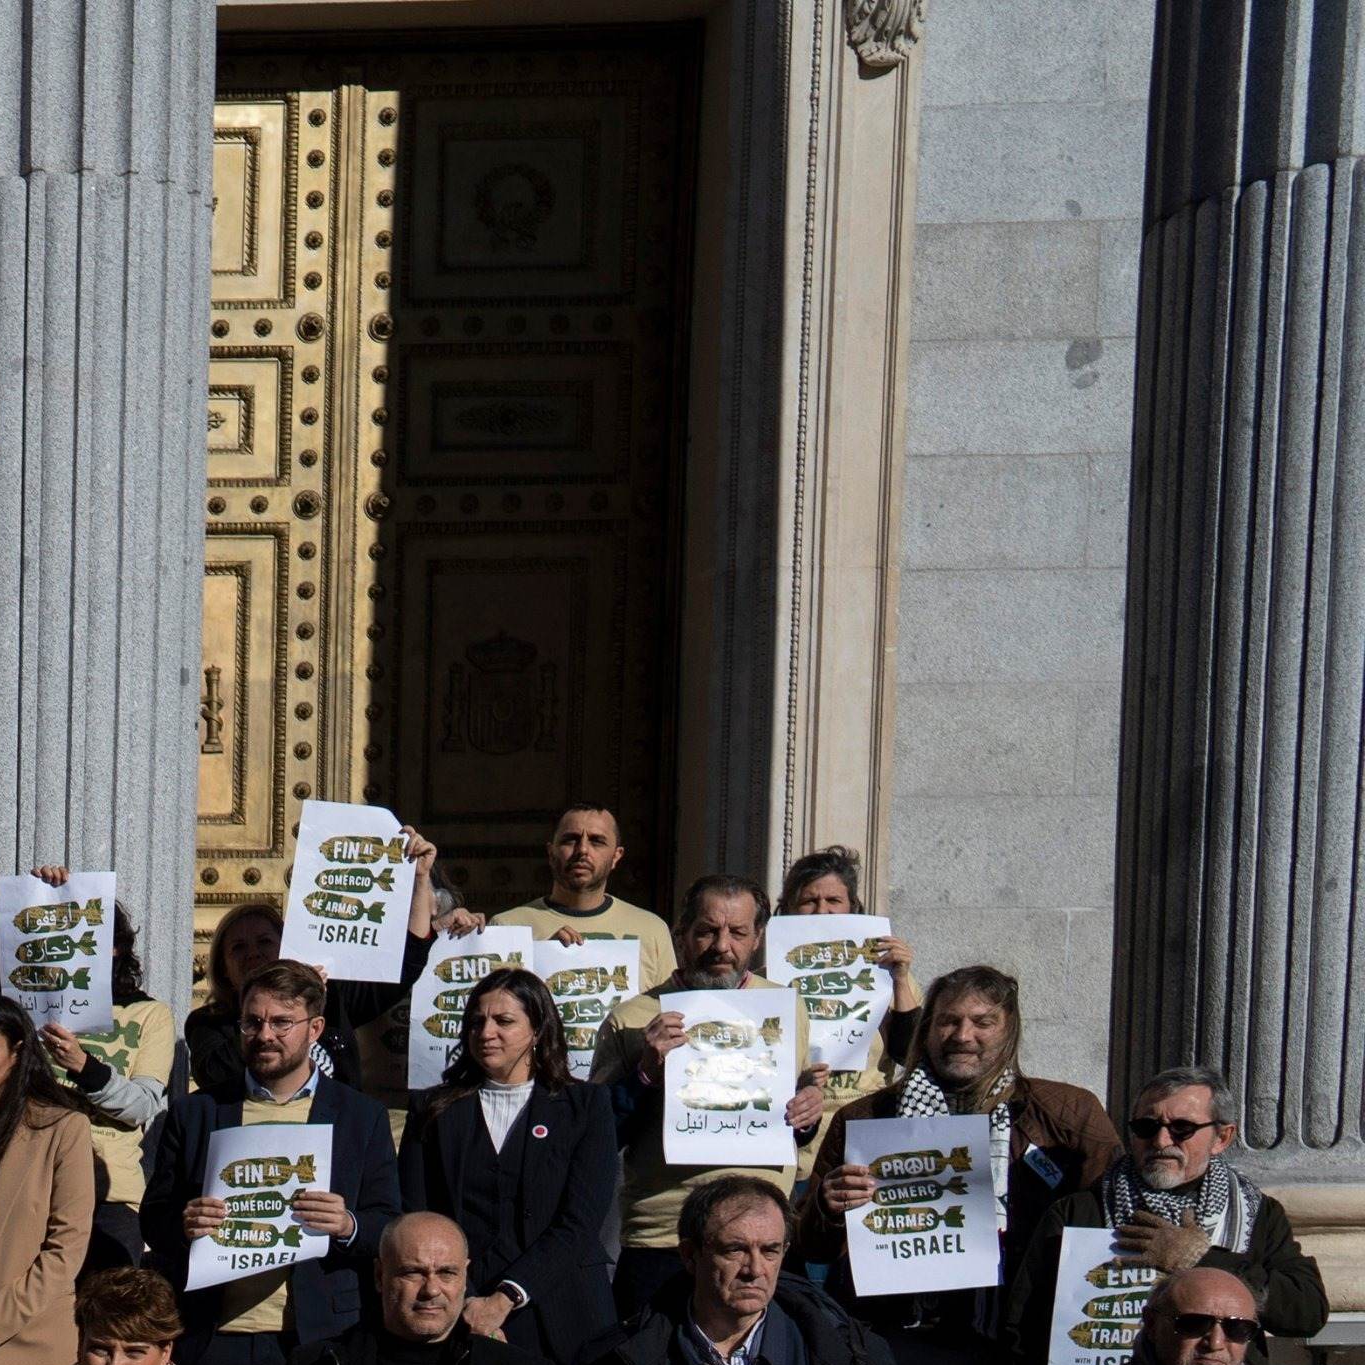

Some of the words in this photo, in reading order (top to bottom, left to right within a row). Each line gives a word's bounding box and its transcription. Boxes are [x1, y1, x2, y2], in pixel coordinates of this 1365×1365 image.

[334, 841, 359, 859] FIN
[321, 875, 371, 888] COMERCIO
[325, 902, 359, 915] ARMAS
[319, 924, 378, 947] ISRAEL
[234, 1165, 263, 1184] FIN
[878, 1184, 937, 1202] COMERÇ
[224, 1200, 282, 1213] COMERCIO
[234, 1229, 271, 1242] ARMAS
[892, 1234, 965, 1259] ISRAEL
